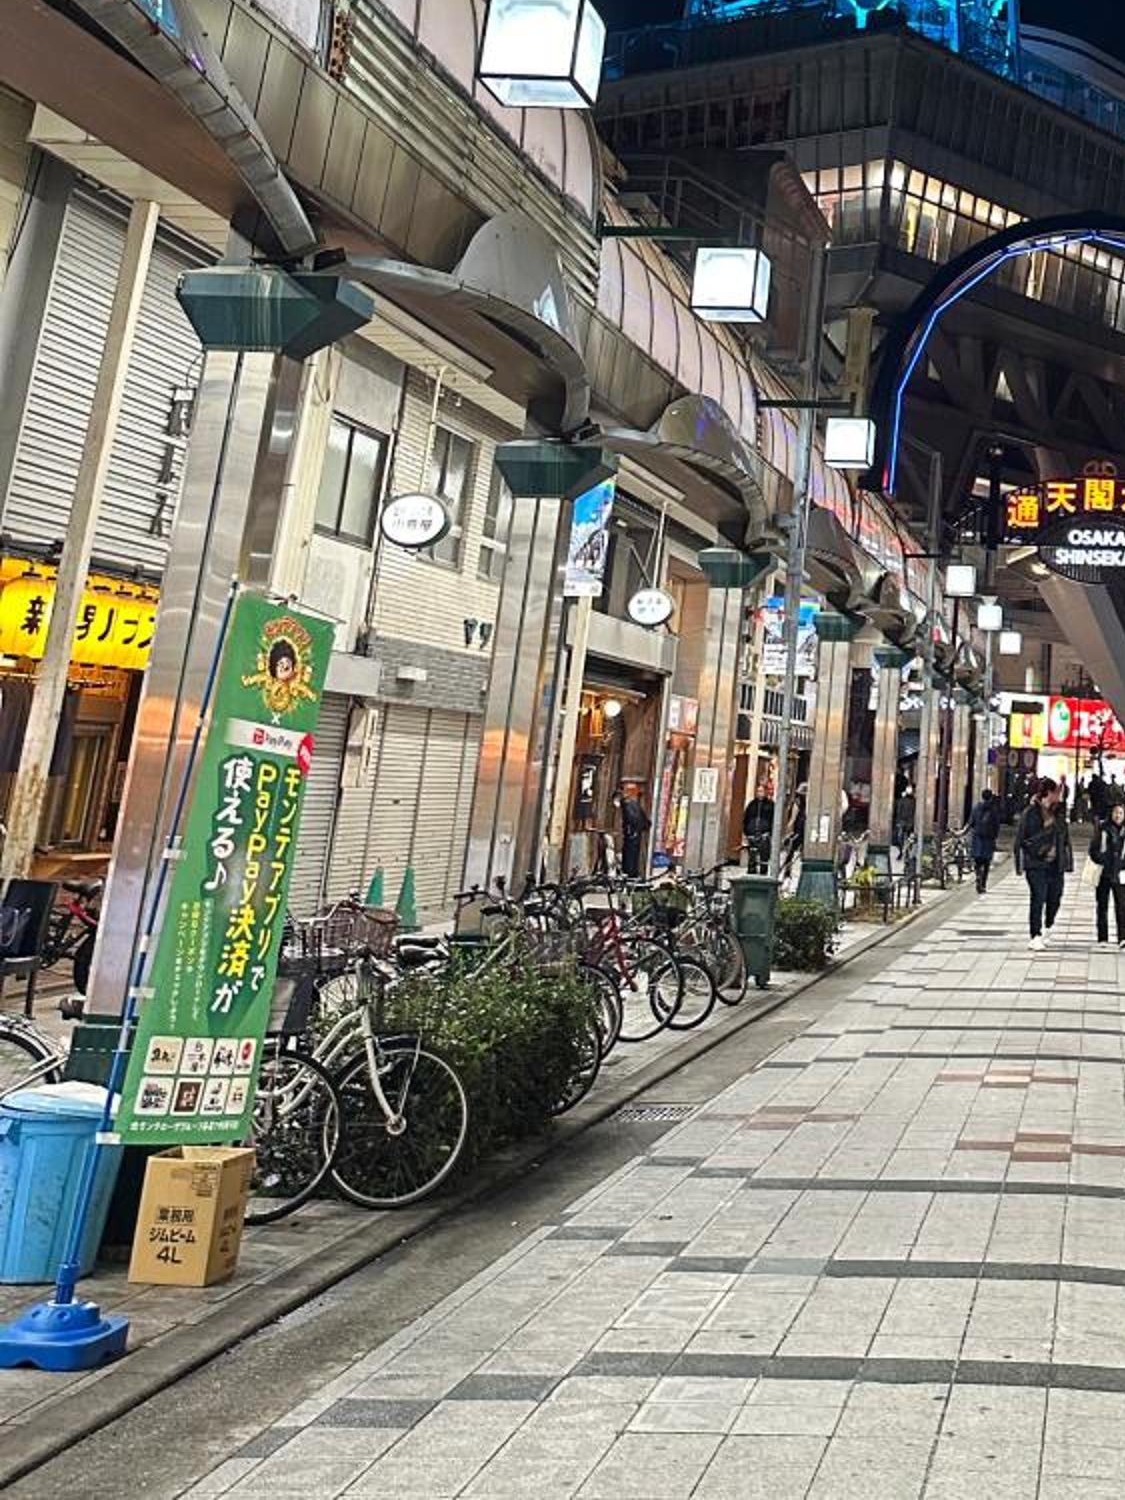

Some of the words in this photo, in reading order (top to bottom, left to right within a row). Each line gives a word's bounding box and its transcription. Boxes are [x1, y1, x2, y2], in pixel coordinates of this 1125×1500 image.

[210, 756, 255, 859] 使える
[249, 768, 300, 991] モンテアプリで
[149, 1227, 196, 1244] ジムビーム
[156, 1245, 183, 1265] 4L
